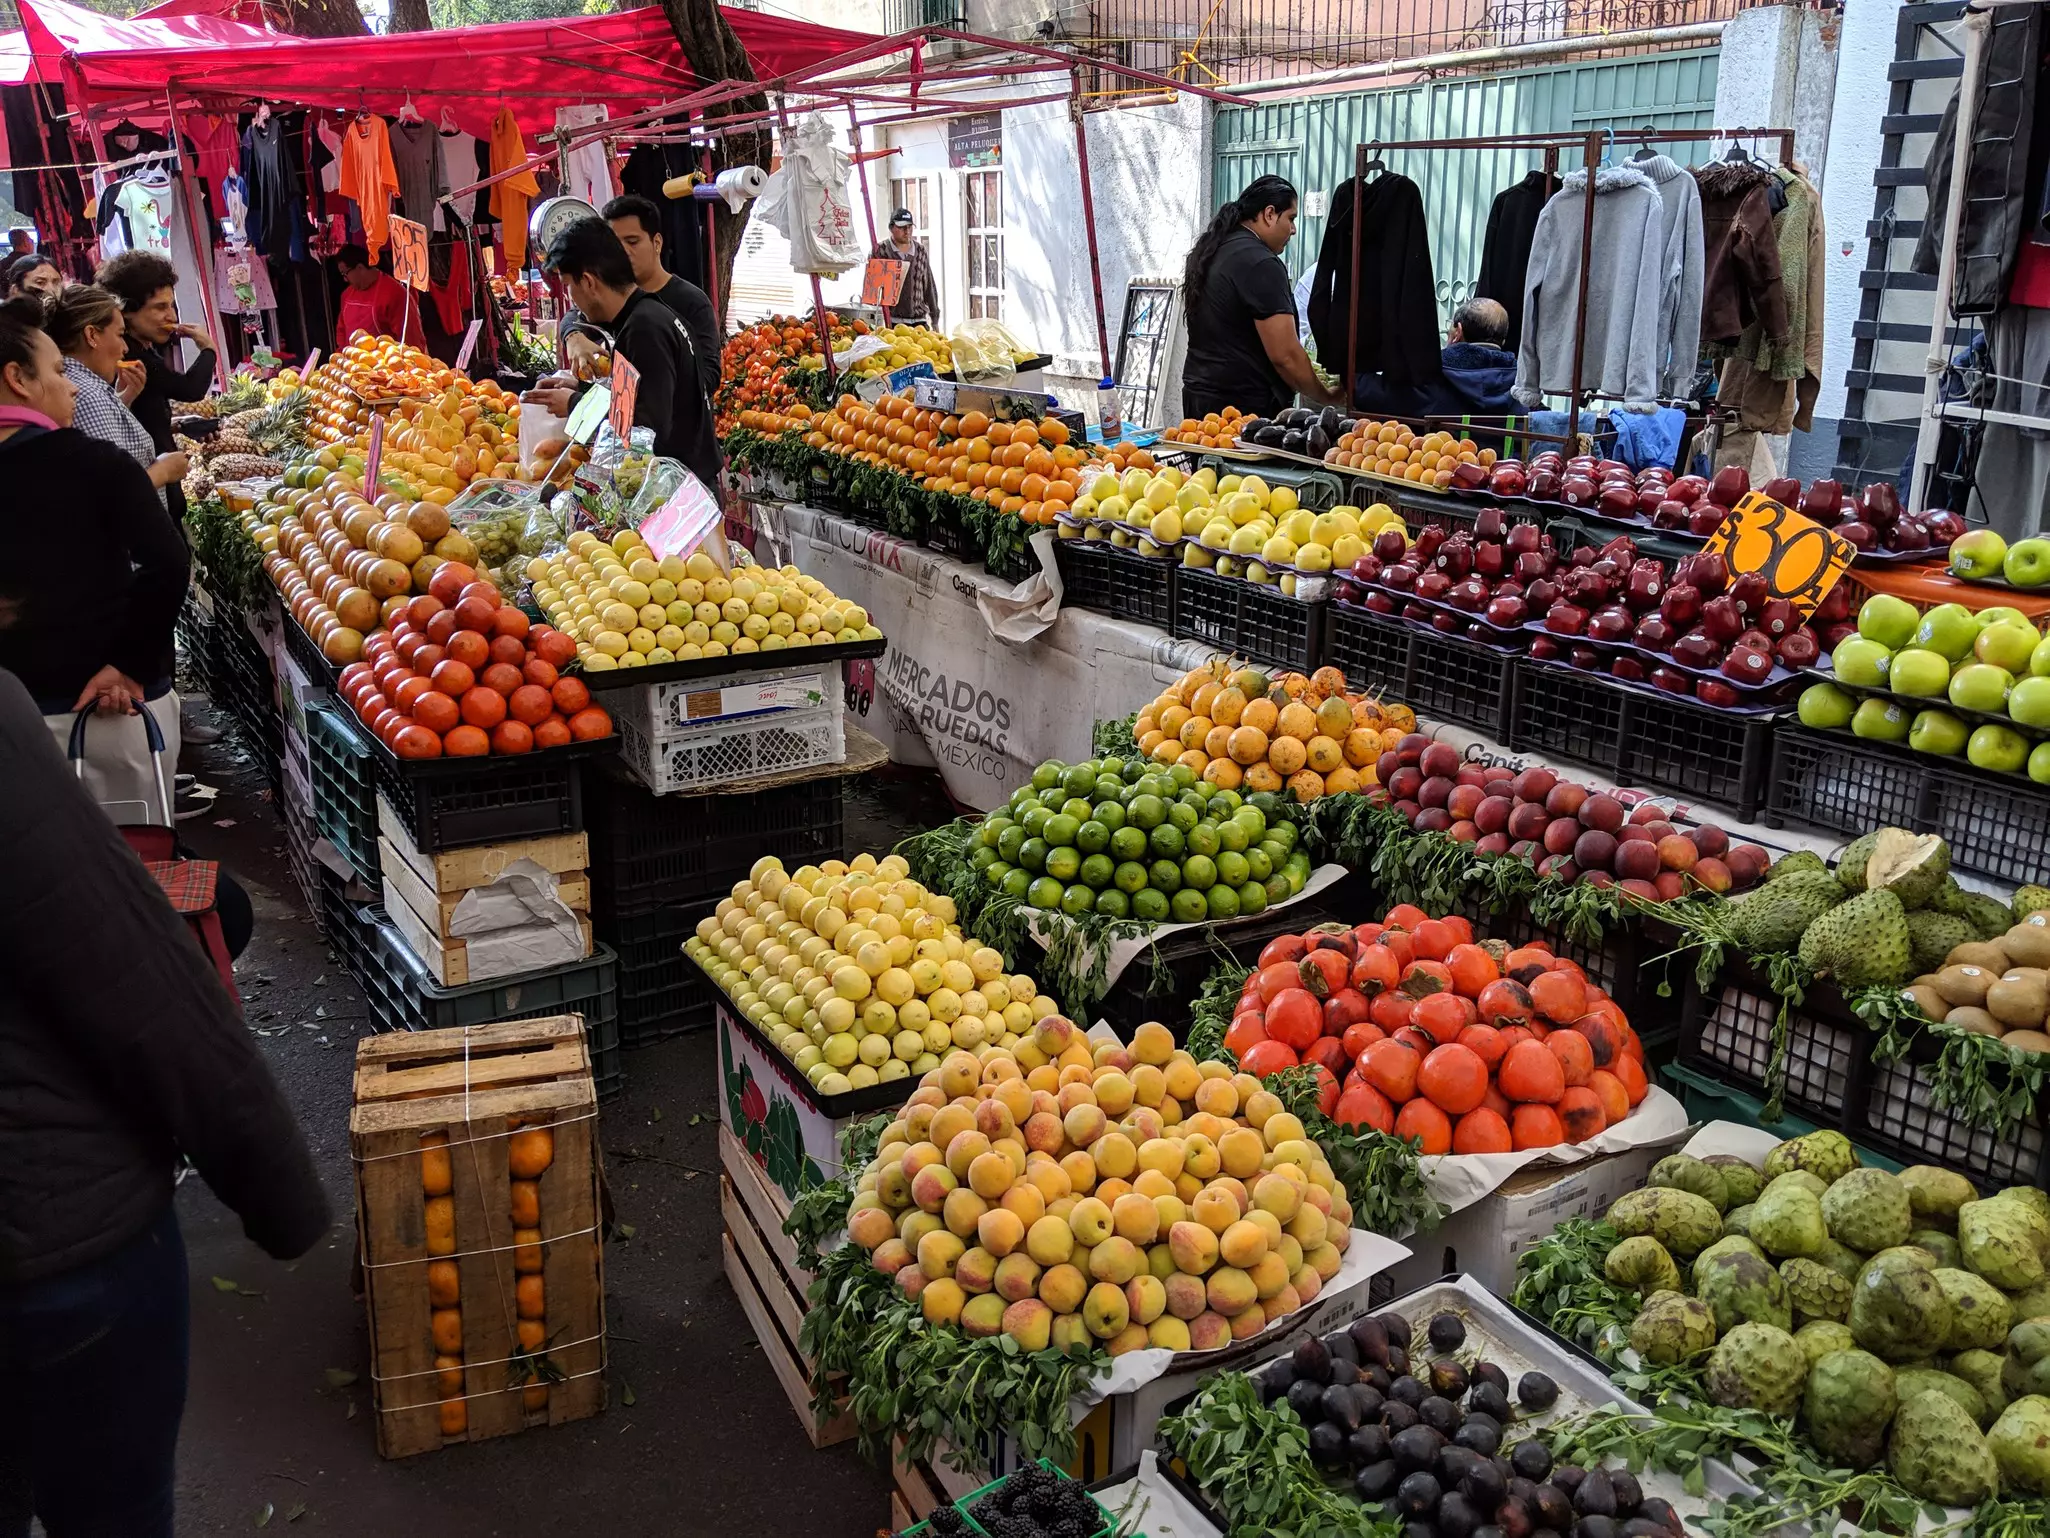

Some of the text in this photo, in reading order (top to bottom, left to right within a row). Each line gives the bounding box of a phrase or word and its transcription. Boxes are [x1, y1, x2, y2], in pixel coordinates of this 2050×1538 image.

[954, 142, 969, 150] ALTA
[952, 574, 977, 600] Capit
[887, 648, 1011, 730] MERCADOS
[920, 703, 1008, 756] RUEDAS
[936, 740, 1006, 781] MÉXICO
